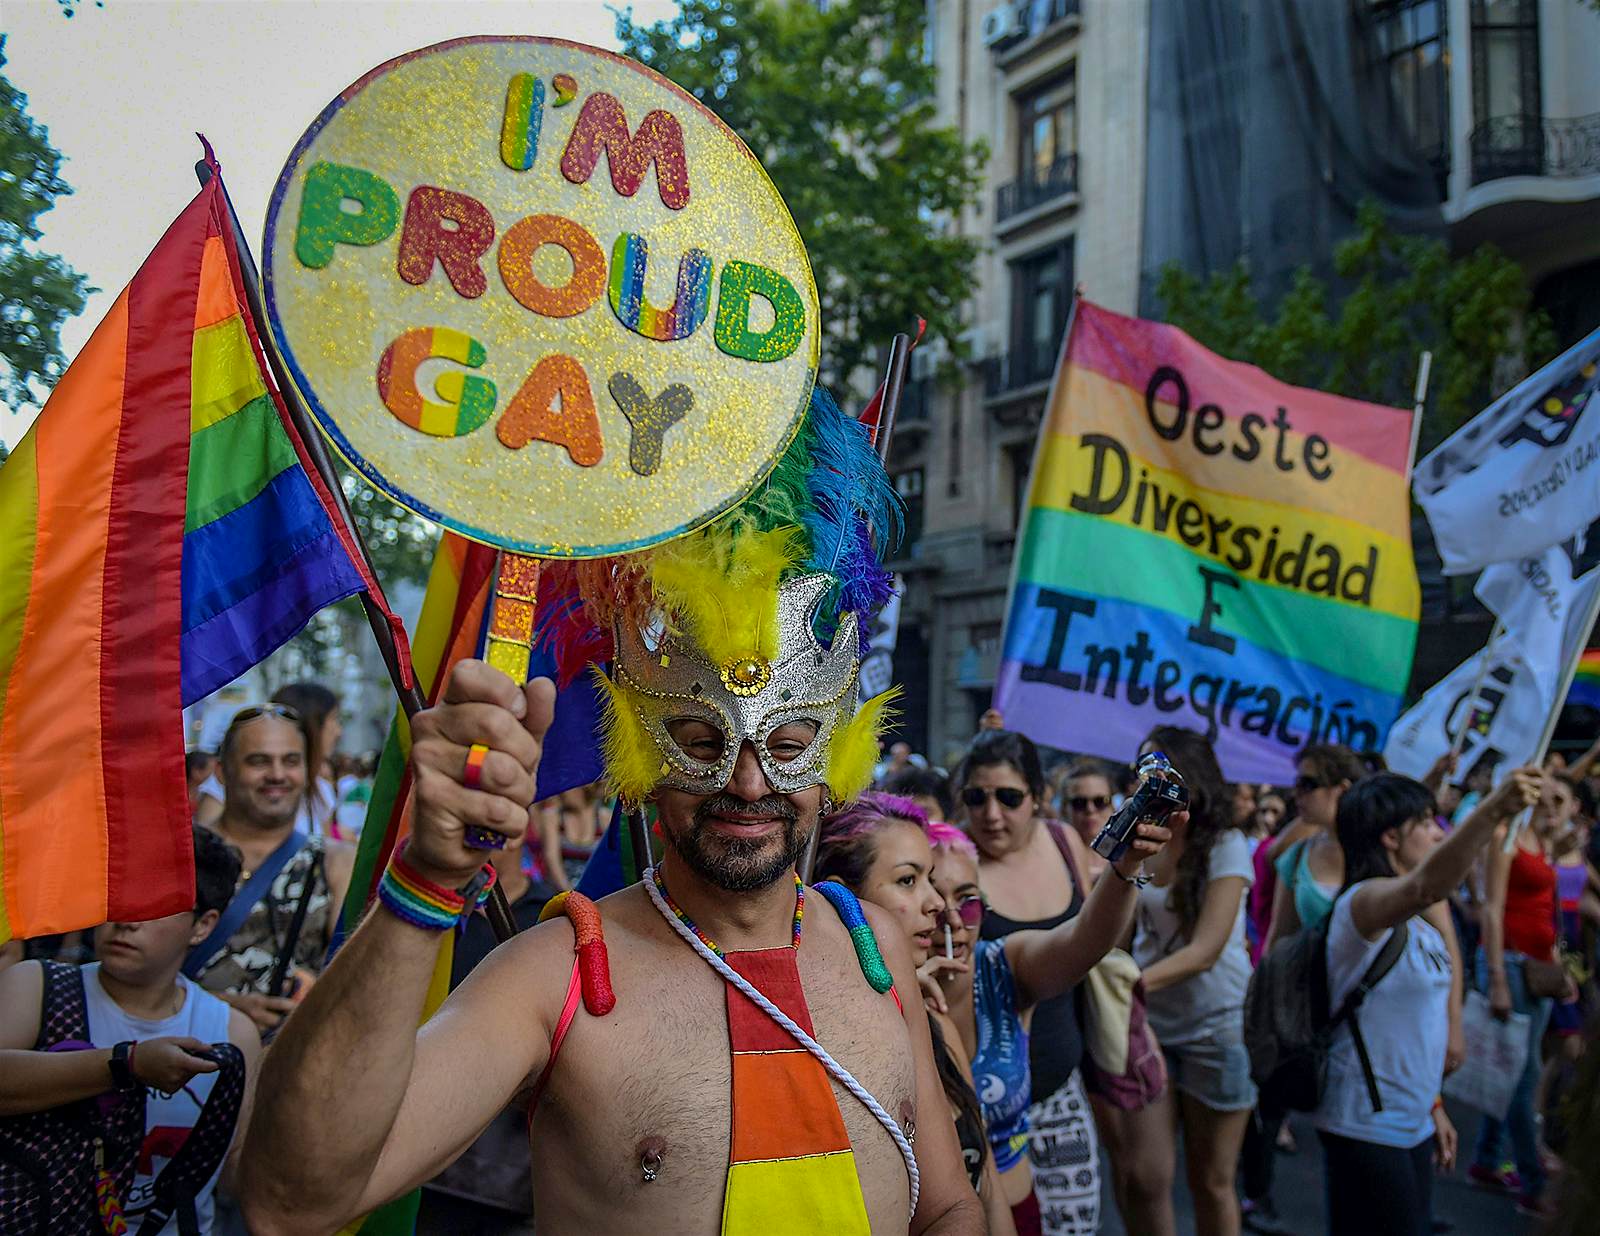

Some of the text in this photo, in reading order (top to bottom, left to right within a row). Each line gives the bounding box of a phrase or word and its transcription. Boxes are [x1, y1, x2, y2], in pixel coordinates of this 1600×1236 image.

[500, 71, 691, 210] I'M
[295, 161, 805, 362] PROUD
[376, 327, 694, 476] GAY
[1145, 366, 1333, 481] Oeste
[1070, 433, 1379, 608] Diversidad
